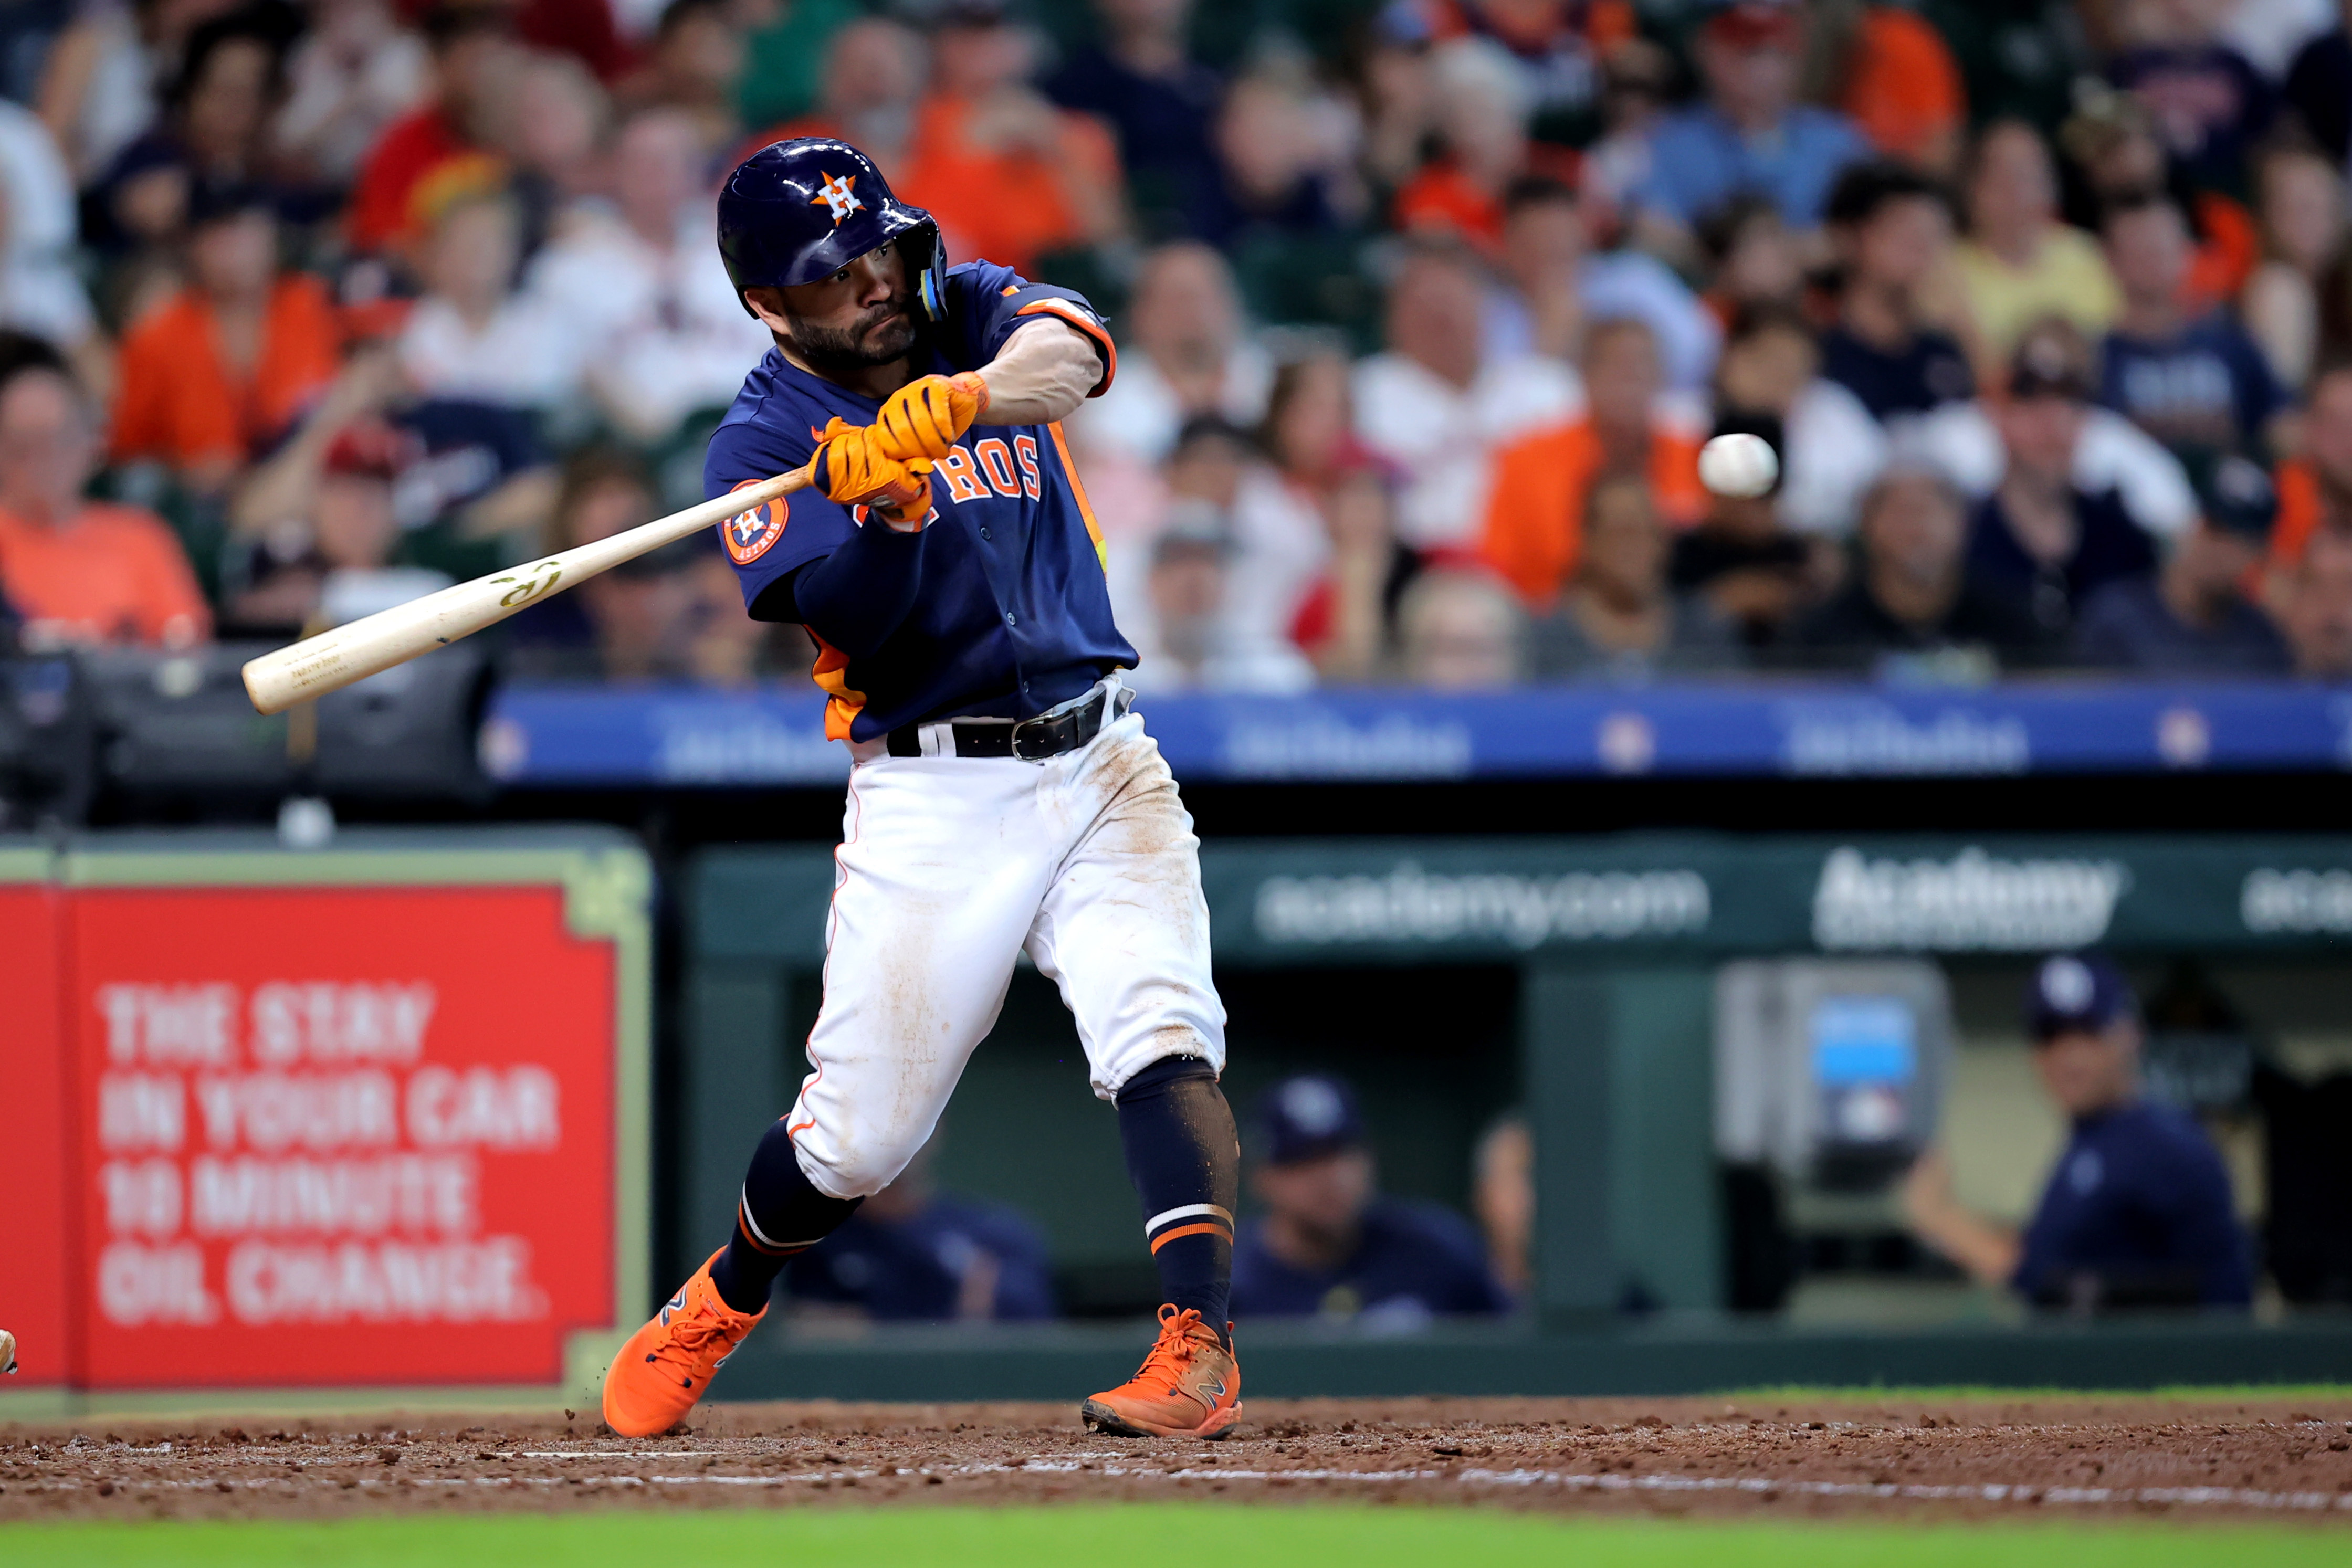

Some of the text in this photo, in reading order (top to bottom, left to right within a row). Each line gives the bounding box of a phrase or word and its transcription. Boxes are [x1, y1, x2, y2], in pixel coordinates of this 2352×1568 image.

[739, 522, 780, 559] ASTROS
[1259, 861, 1708, 946] academy.com
[1814, 847, 2126, 929] Academy
[101, 984, 433, 1061] THE STAY
[101, 1066, 558, 1150] IN YOUR CAR
[101, 1154, 478, 1236] 10 MINUTE
[101, 1238, 548, 1324] OIL CHANGE.
